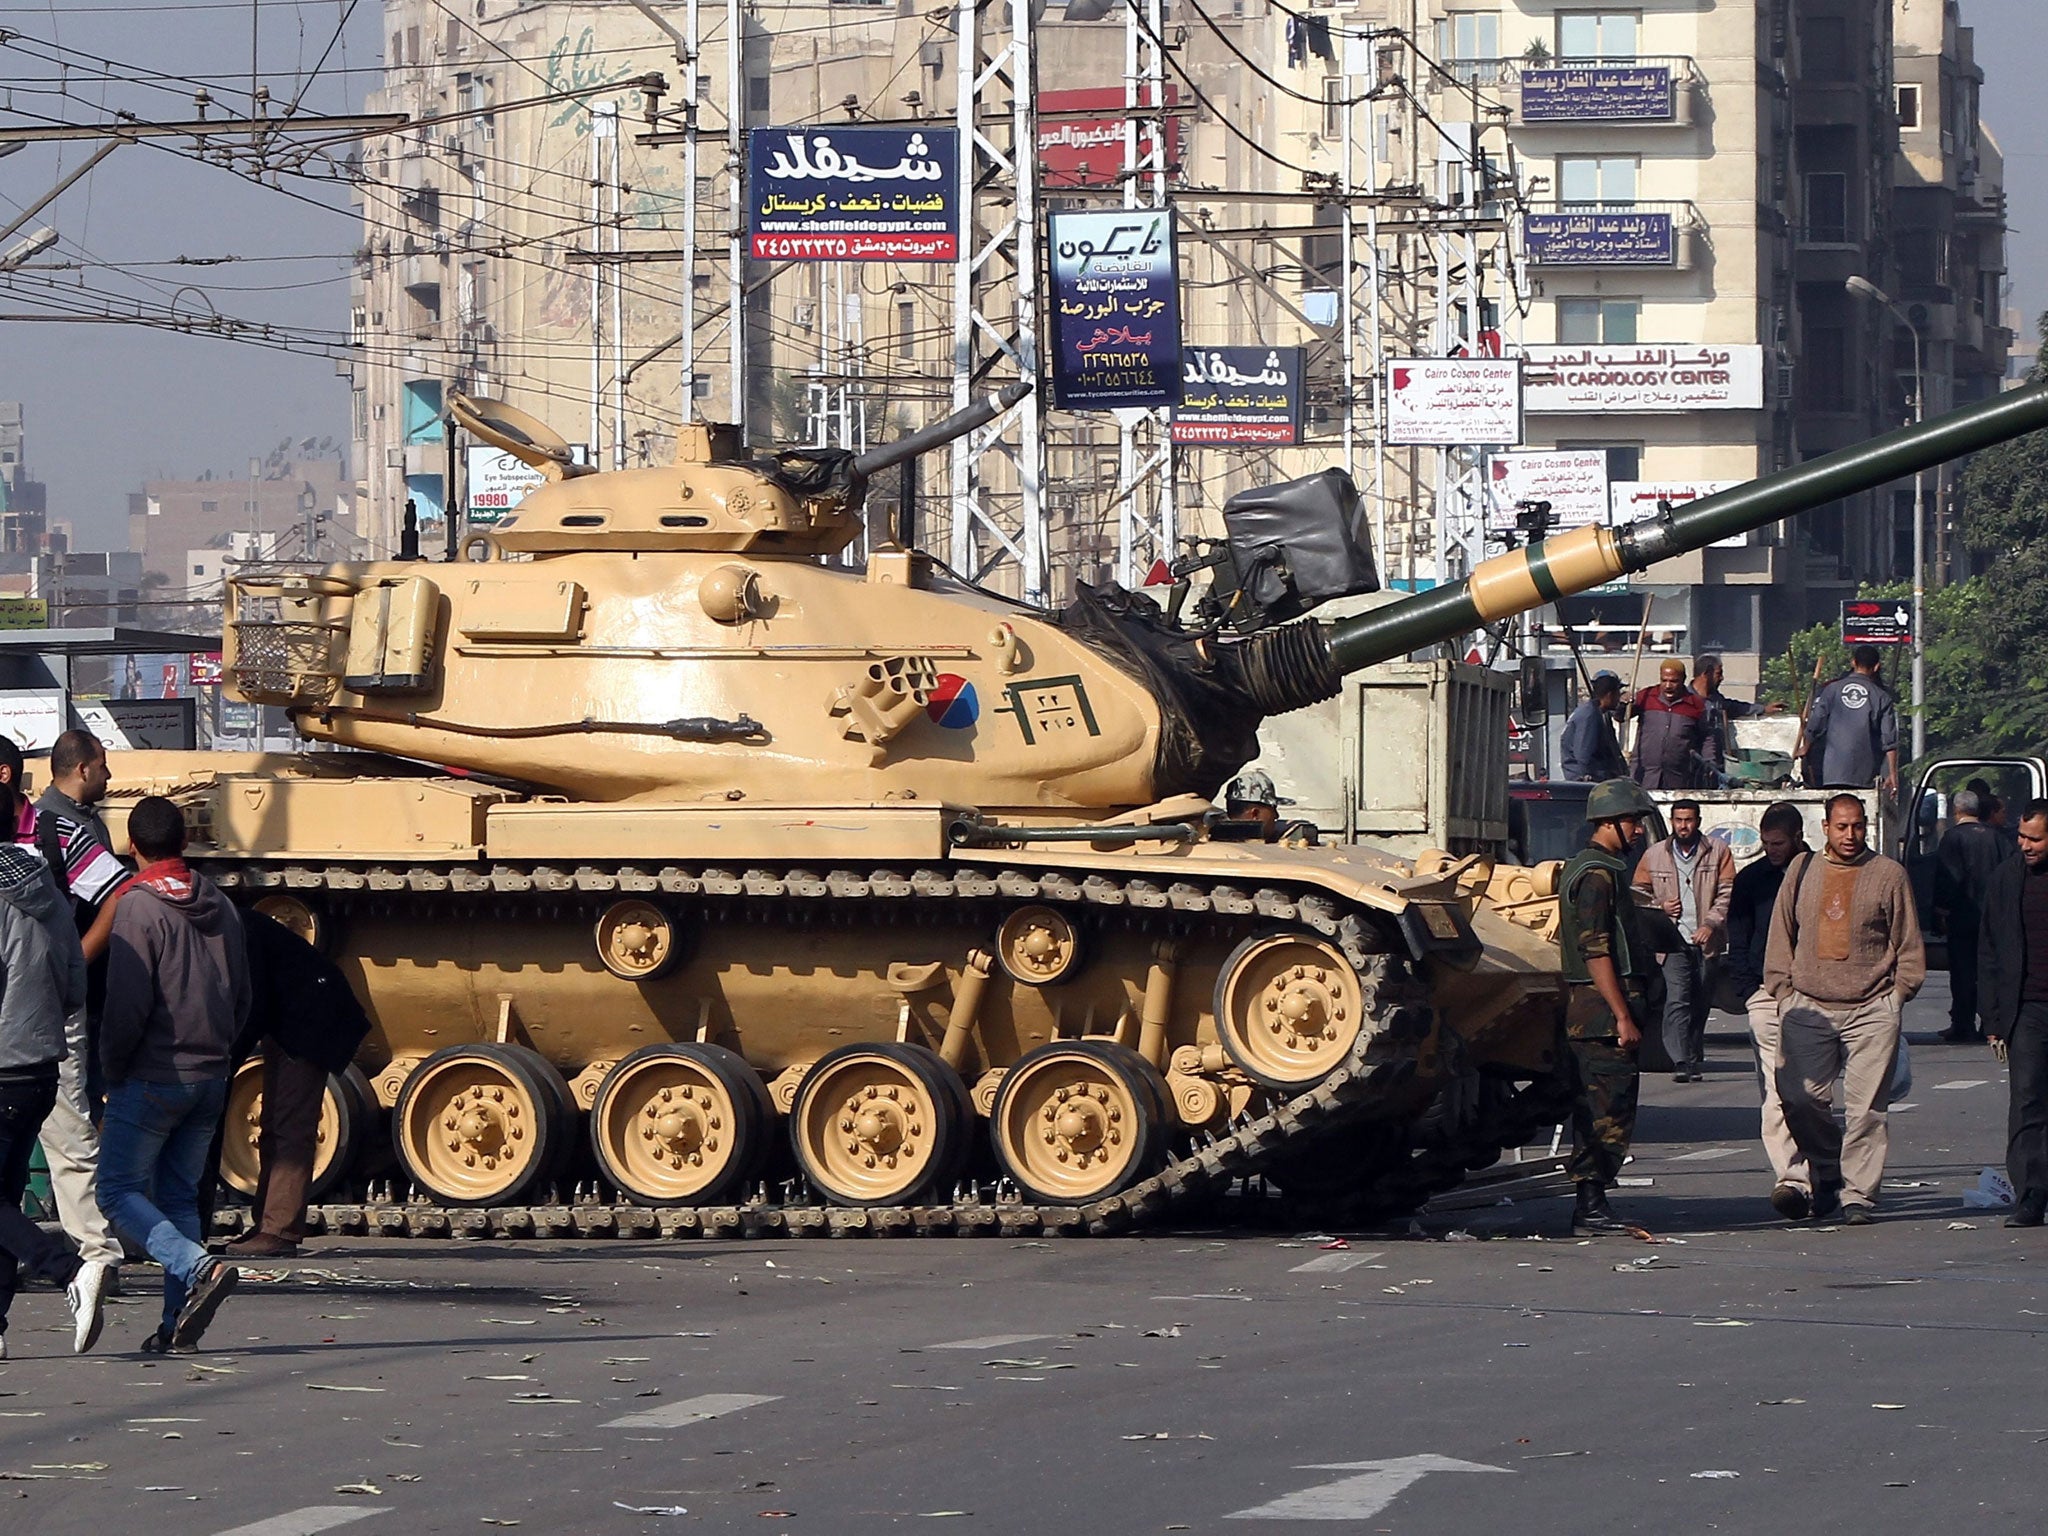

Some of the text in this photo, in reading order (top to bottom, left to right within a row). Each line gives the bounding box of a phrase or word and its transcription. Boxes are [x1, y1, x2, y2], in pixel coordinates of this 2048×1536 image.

[1594, 72, 1619, 92] عبد
[763, 132, 943, 182] شيفلد
[760, 193, 944, 216] فضيات تحف كريستال
[760, 218, 947, 233] www.sheffieldegypt.com
[1597, 219, 1619, 238] عبد
[1621, 217, 1647, 238] وليد
[756, 238, 847, 256] ٢٤٥٣٢٣٣٥
[850, 238, 887, 255] دمشق
[886, 241, 902, 256] مع
[904, 238, 936, 255] بيروت
[1059, 217, 1163, 270] تايكون
[1094, 261, 1152, 275] القابضة
[1075, 282, 1148, 295] للاستثمارات المالية
[1060, 296, 1119, 320] البورصة
[1076, 325, 1153, 351] ببلاش
[1083, 352, 1149, 369] ٢٢٩١٦٥٣٥
[1523, 349, 1731, 370] مركز القلب الحدي
[1183, 350, 1288, 387] شيفلد
[1424, 367, 1513, 379] Cairo Cosmo Center
[1077, 370, 1155, 387] ٠١٠٠٢٥٥٦٦٤٤
[1566, 371, 1669, 386] CARDIOLOGY
[1671, 370, 1731, 385] CENTER
[1067, 388, 1166, 399] www.tycoonsecurities.com
[1224, 394, 1251, 408] تحف
[1567, 389, 1729, 404] لتشخيص وعلاج أمراض القلب
[1255, 394, 1288, 411] فضيات
[1521, 457, 1601, 470] Cairo Cosmo Center
[484, 473, 543, 483] Eye Subspecialty
[472, 493, 509, 507] 19980
